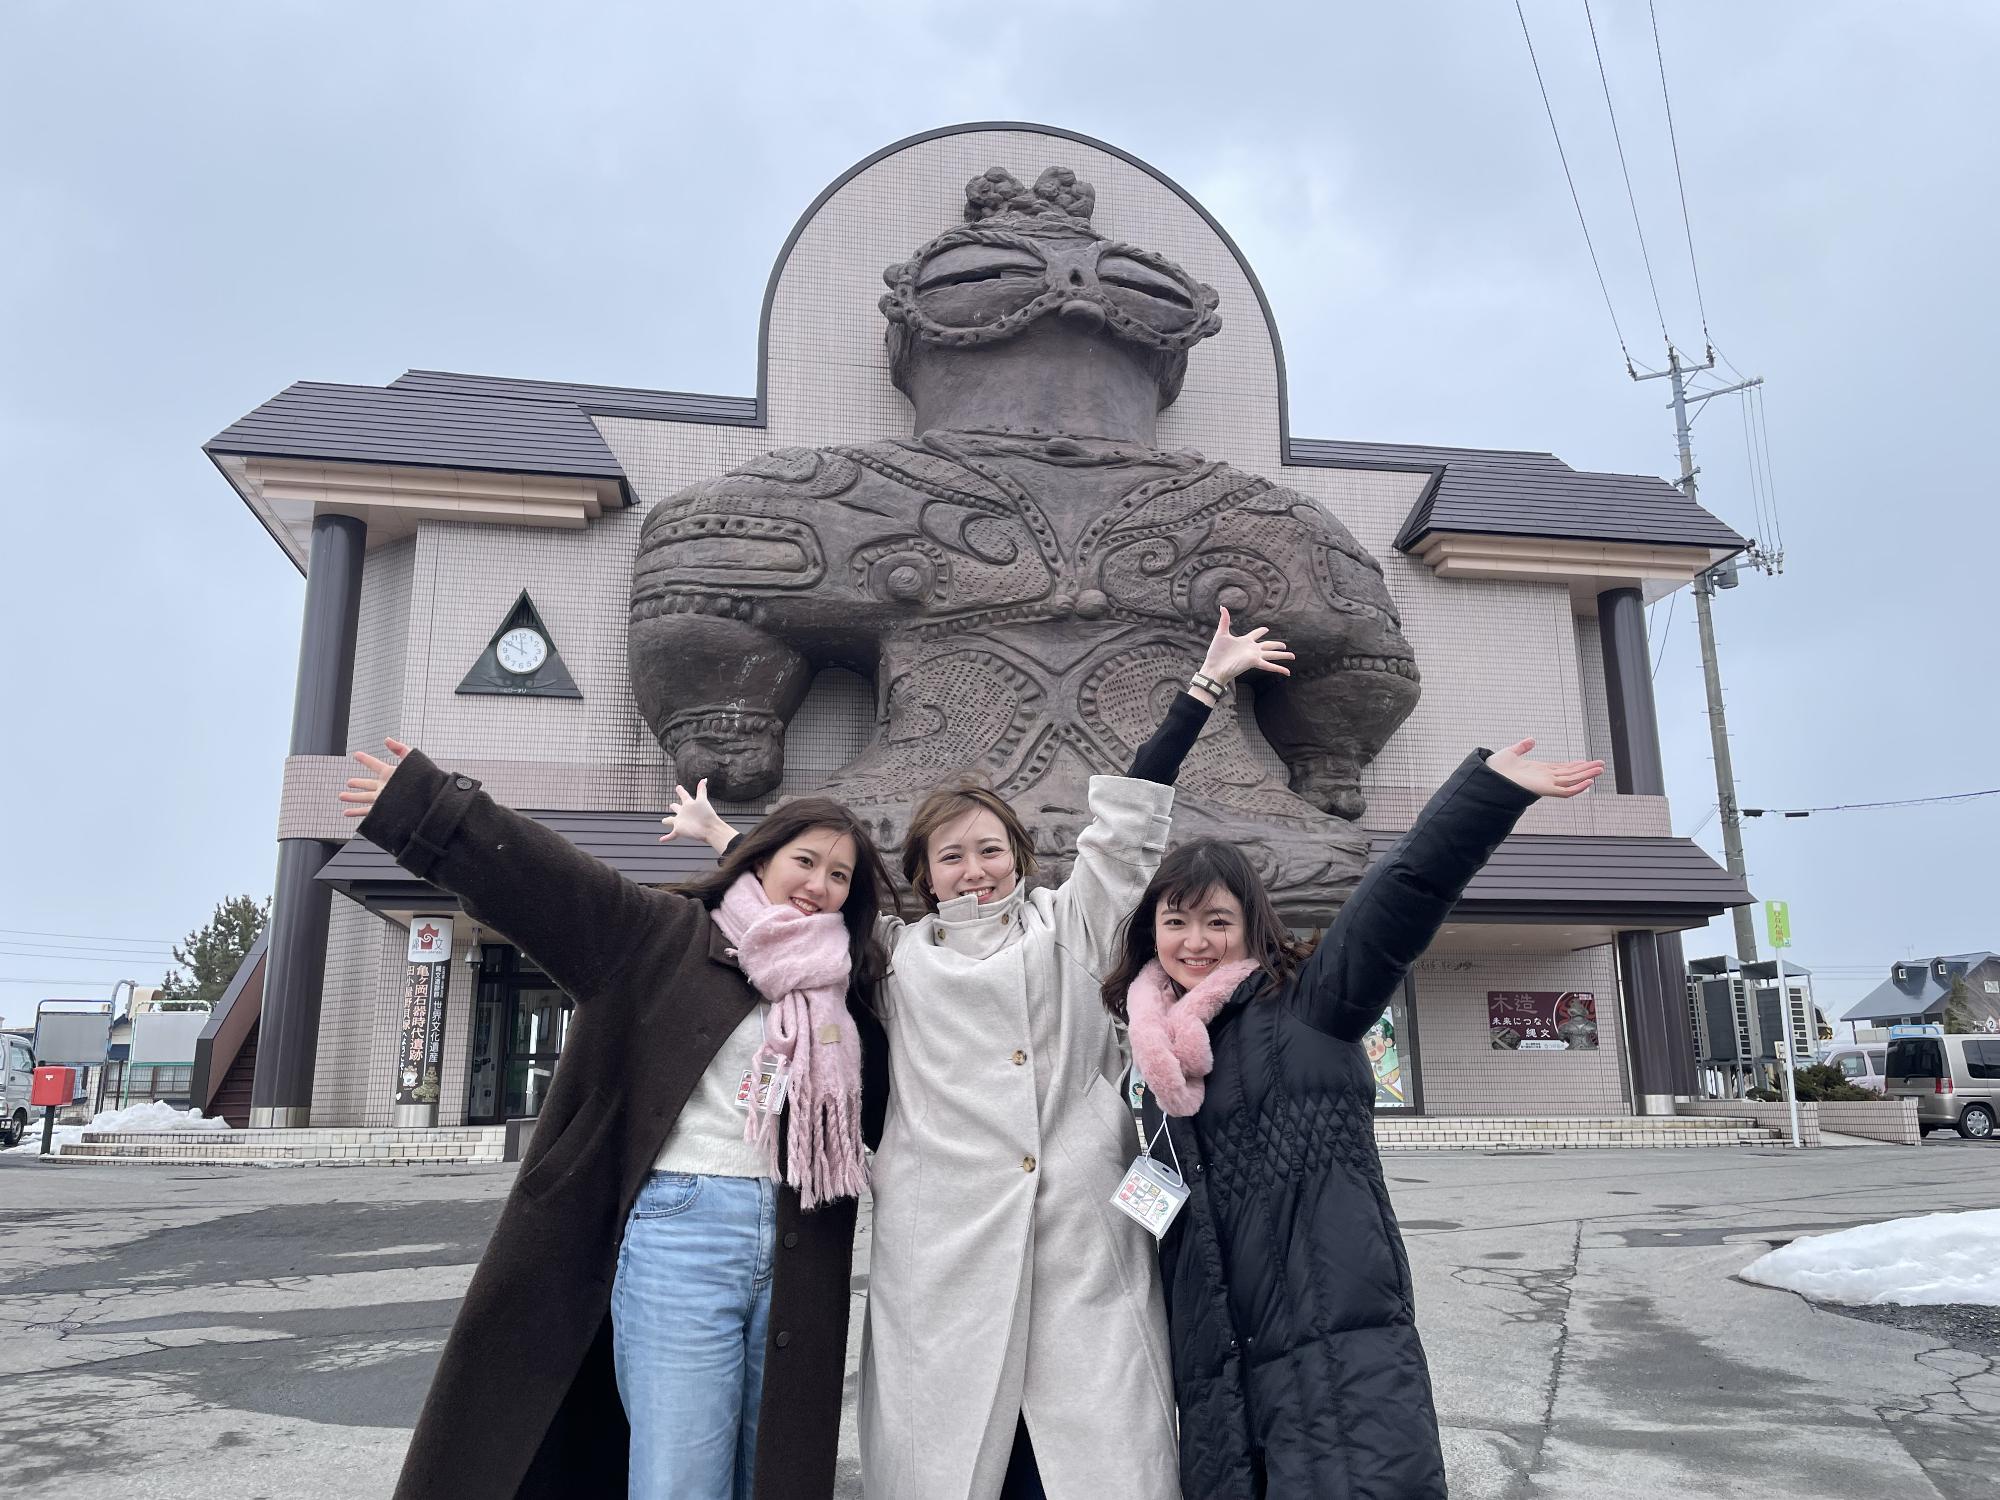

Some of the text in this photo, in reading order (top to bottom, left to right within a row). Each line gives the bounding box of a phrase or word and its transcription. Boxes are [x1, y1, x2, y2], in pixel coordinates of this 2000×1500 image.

[1490, 993, 1539, 1015] 木造
[1492, 1017, 1552, 1026] 未来につなぐ
[1988, 1020, 1995, 1029] 2
[428, 1000, 442, 1063] 世界文化遺産
[1525, 1028, 1551, 1038] 縄文
